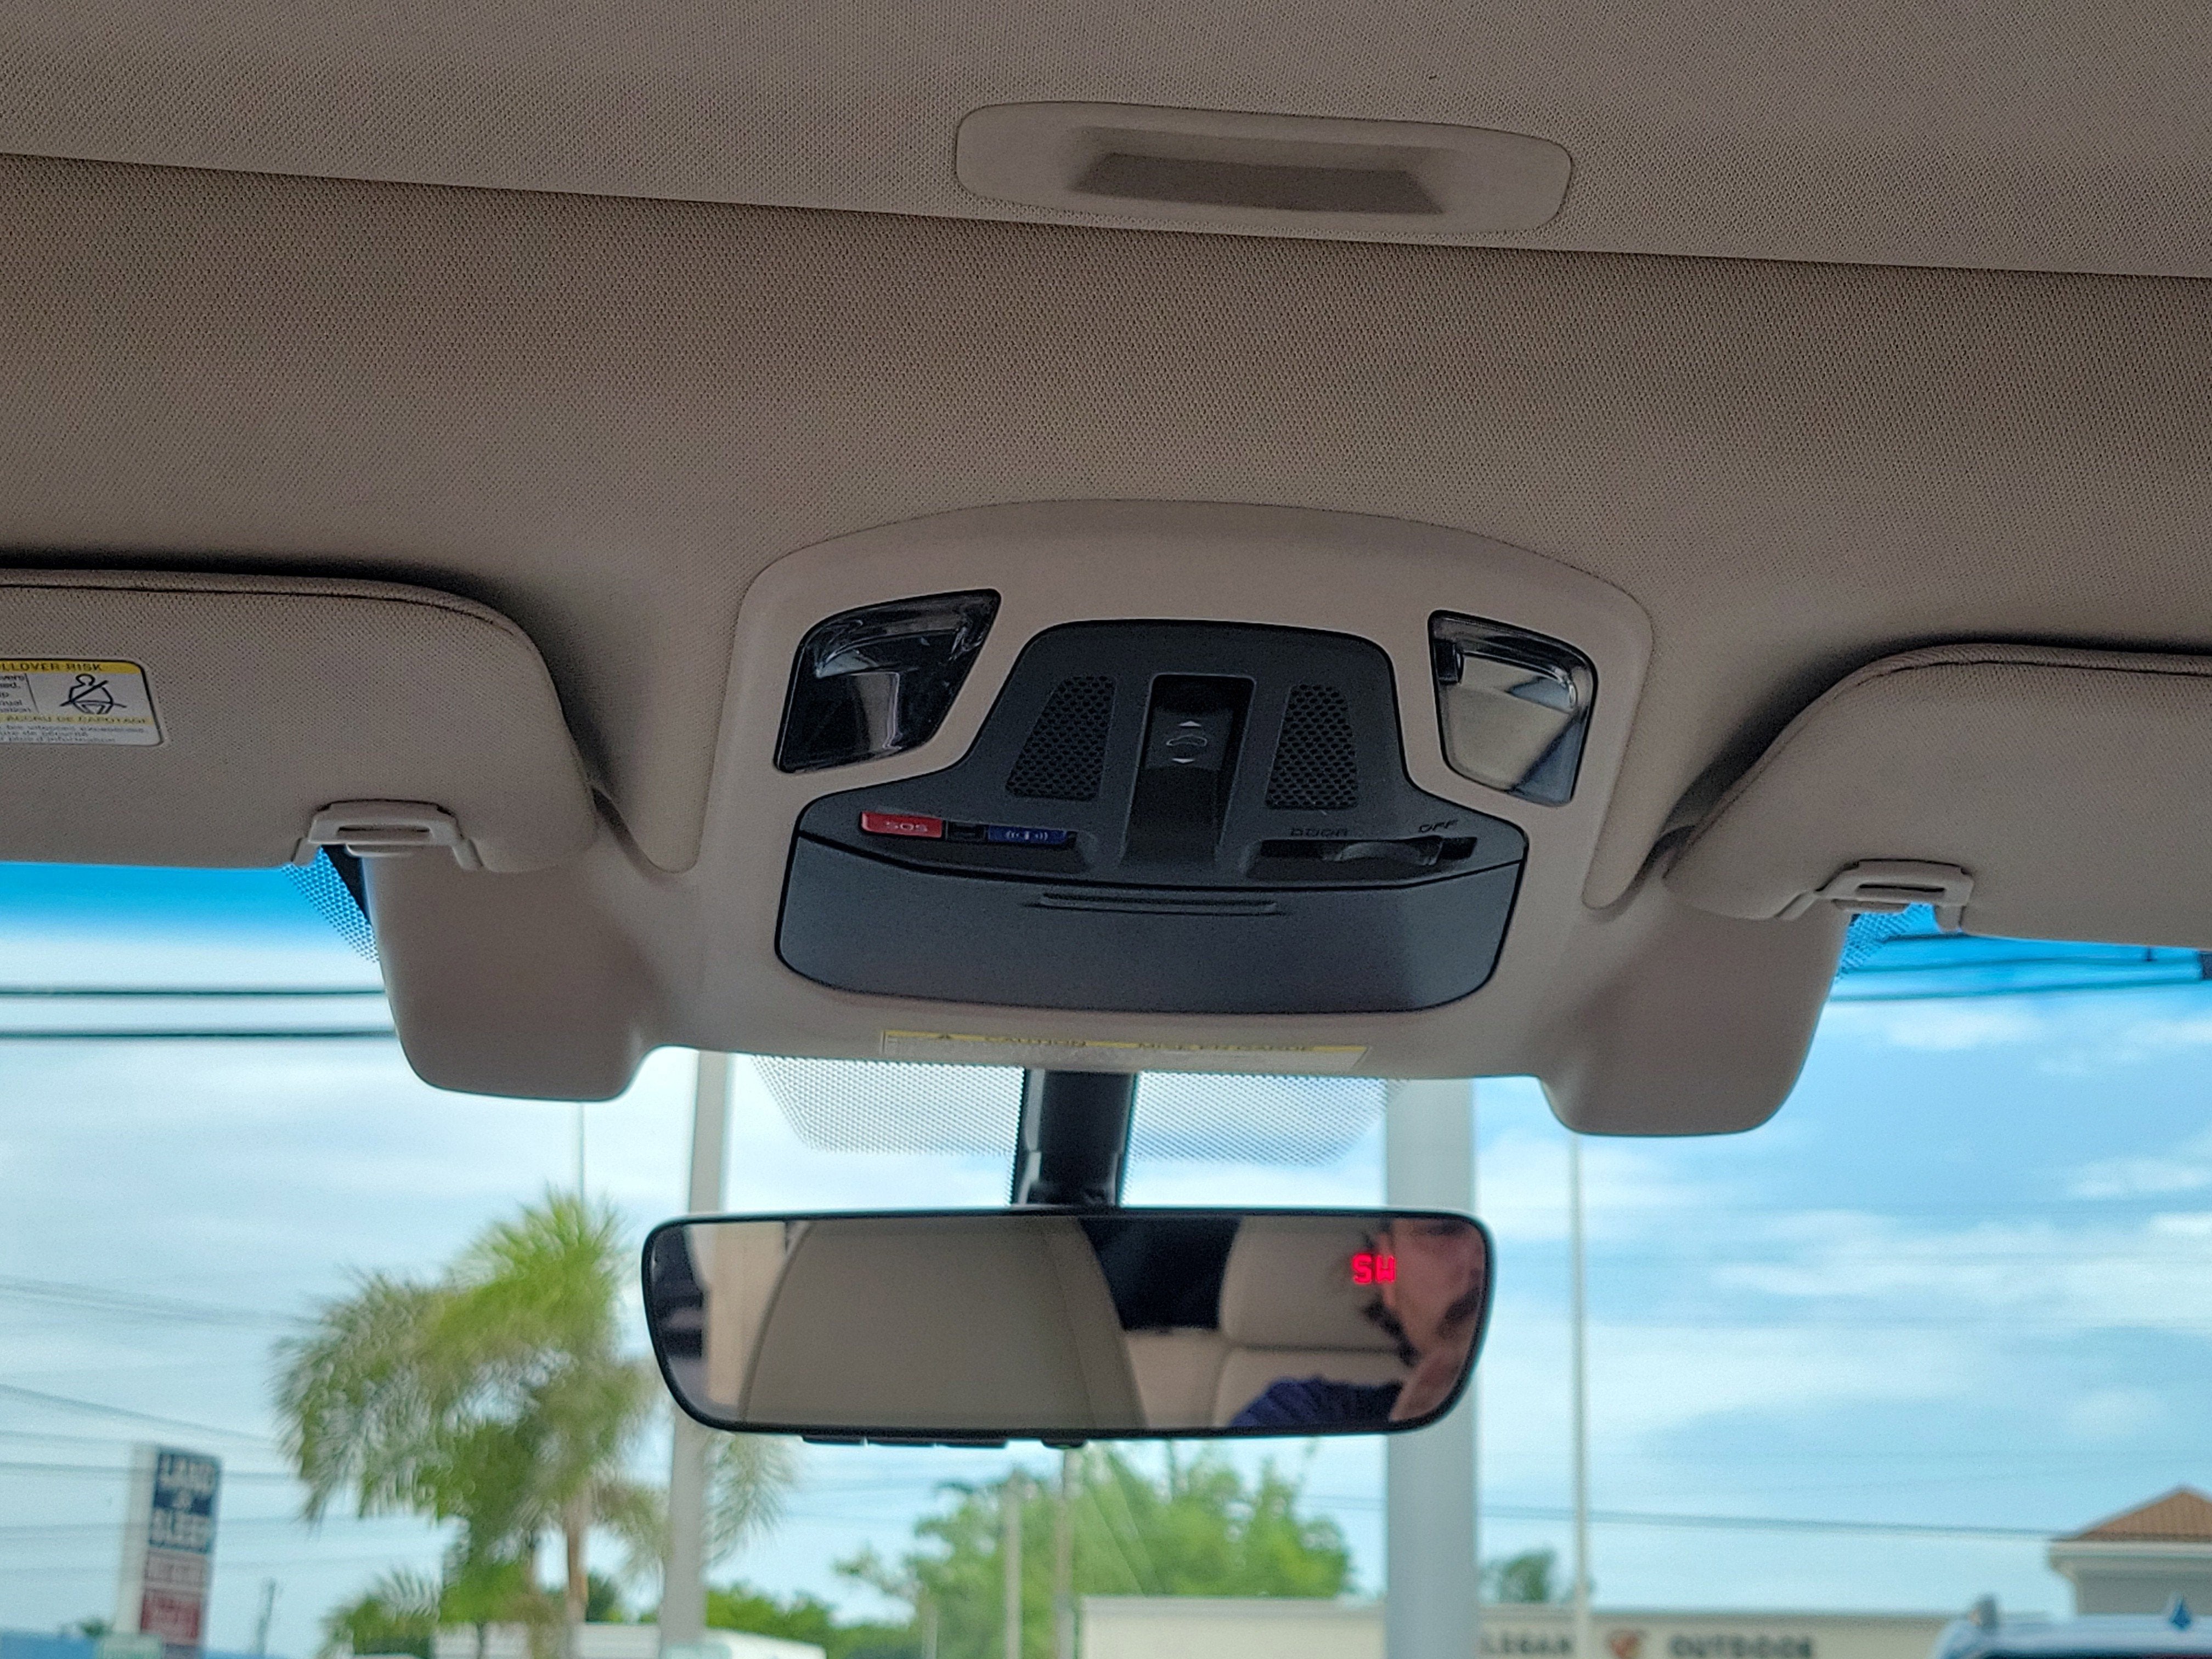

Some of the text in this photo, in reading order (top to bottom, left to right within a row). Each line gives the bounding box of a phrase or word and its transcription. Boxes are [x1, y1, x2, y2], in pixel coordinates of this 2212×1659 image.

[0, 663, 60, 671] LLOVER
[885, 821, 928, 832] SOS
[1418, 820, 1459, 833] OFF
[1352, 1252, 1397, 1285] SW
